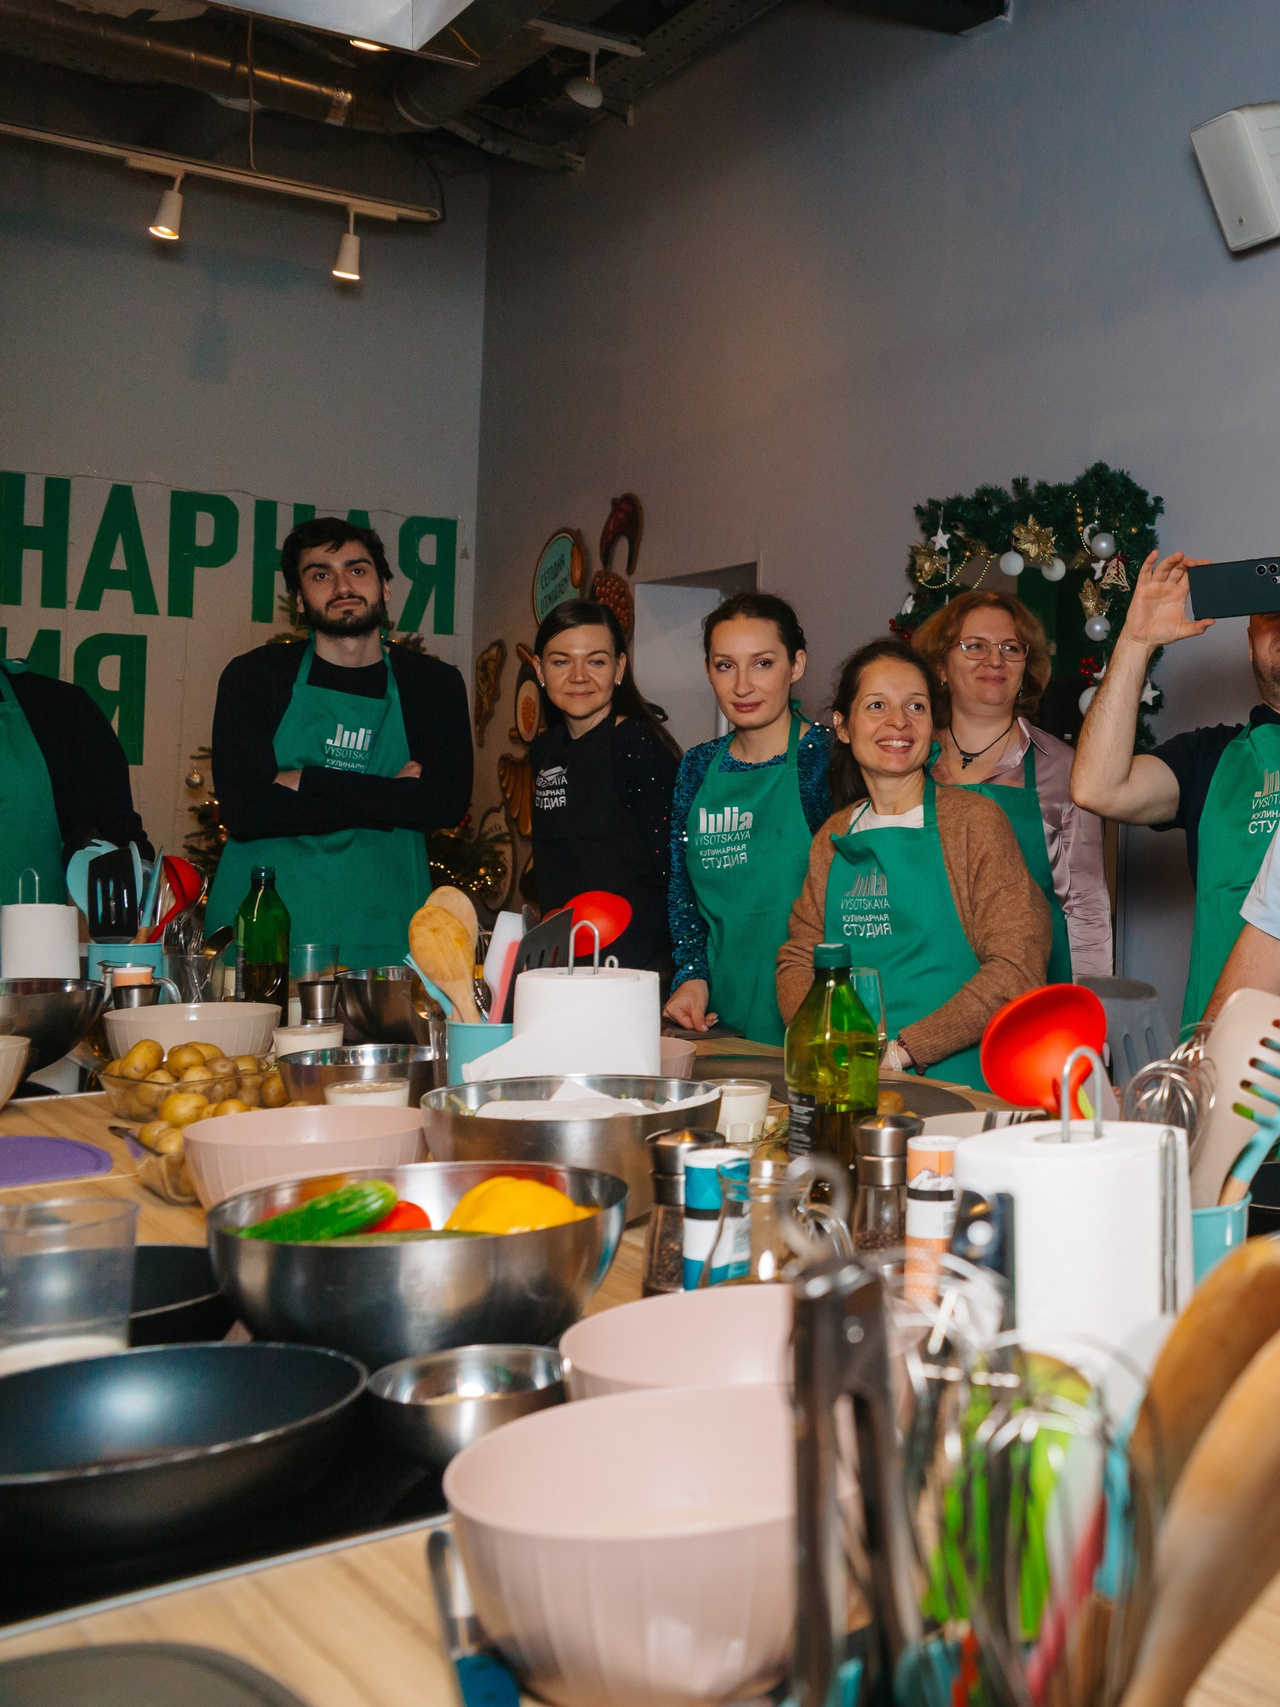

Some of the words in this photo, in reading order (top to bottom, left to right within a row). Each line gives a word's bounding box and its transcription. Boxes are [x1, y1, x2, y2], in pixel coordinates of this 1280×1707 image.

[326, 723, 372, 751] Juli
[324, 745, 368, 760] VYSOTSKA
[326, 758, 365, 770] КУЛИНАРН
[1248, 820, 1277, 834] СТУ
[702, 852, 748, 869] СТУДИЯ
[840, 898, 891, 910] VYSOTSKAYA
[843, 923, 892, 938] СТУДИЯ
